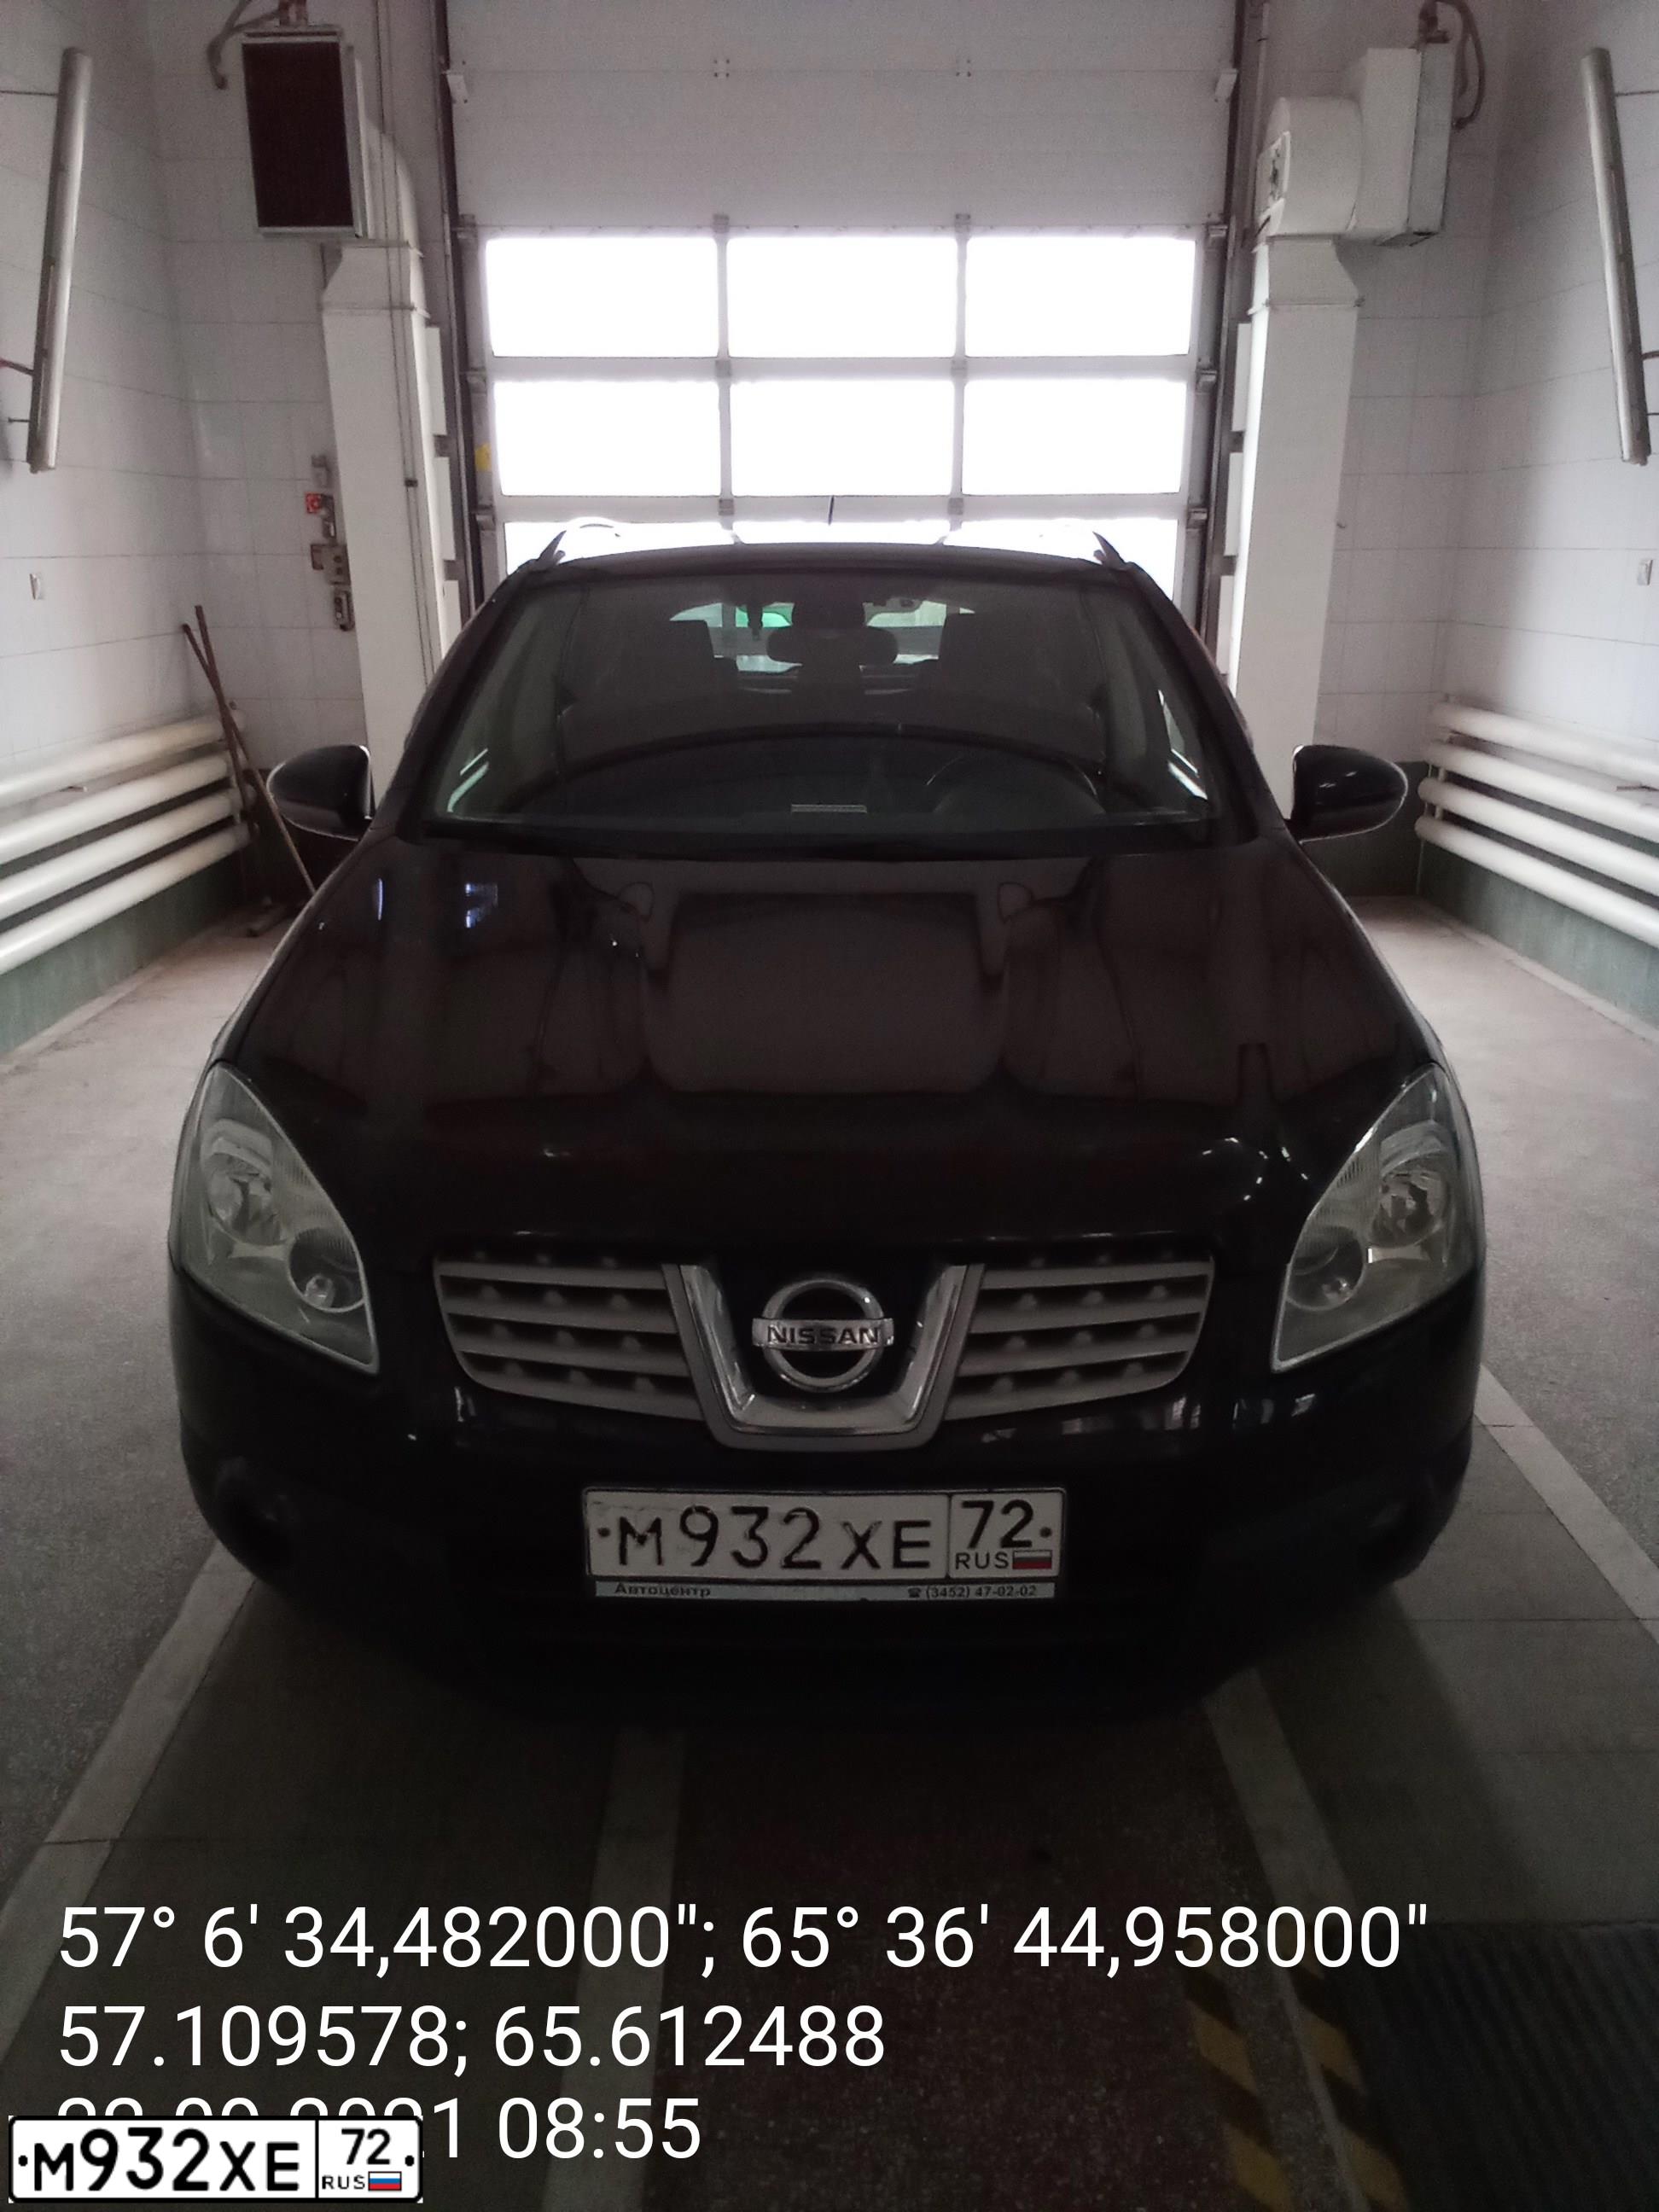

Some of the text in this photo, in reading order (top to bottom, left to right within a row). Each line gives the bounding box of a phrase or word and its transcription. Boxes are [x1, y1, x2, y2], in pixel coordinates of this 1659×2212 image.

[768, 1324, 879, 1345] NISSAN
[961, 1499, 1034, 1550] 72
[955, 1551, 1010, 1570] RUS
[614, 1582, 711, 1598] Автоцентр
[926, 1585, 1037, 1599] (3452) 47-02-02
